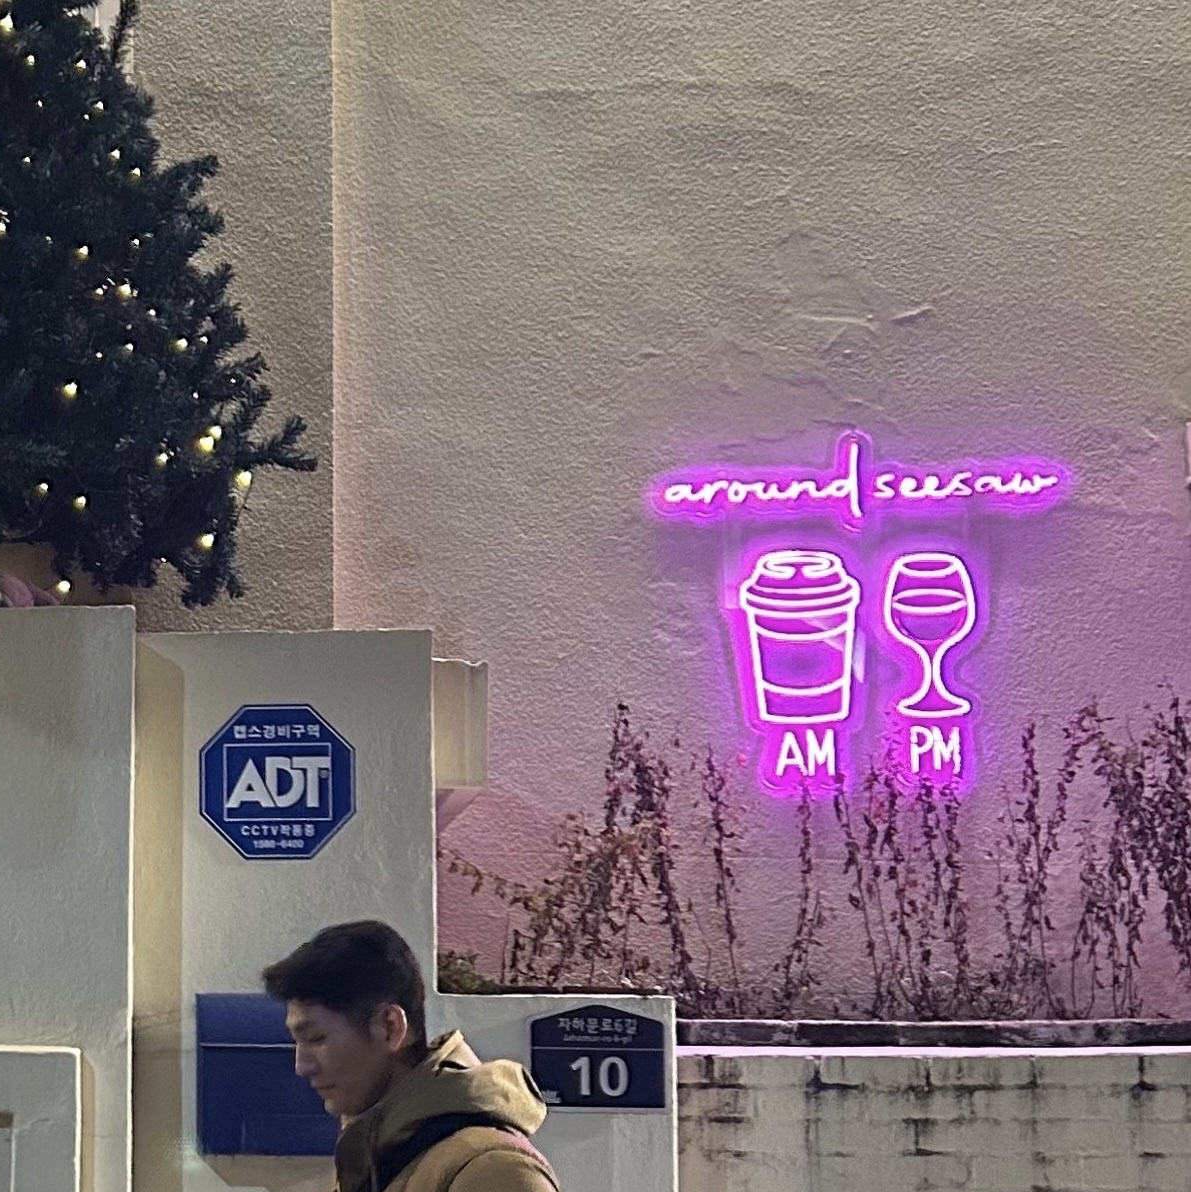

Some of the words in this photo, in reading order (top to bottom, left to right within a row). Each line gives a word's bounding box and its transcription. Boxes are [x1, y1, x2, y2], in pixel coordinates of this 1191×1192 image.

[665, 443, 864, 518] around
[874, 471, 1058, 498] seesaw
[775, 728, 836, 776] AM
[910, 725, 962, 774] PM
[225, 756, 331, 809] ADT
[570, 1056, 629, 1097] 10
